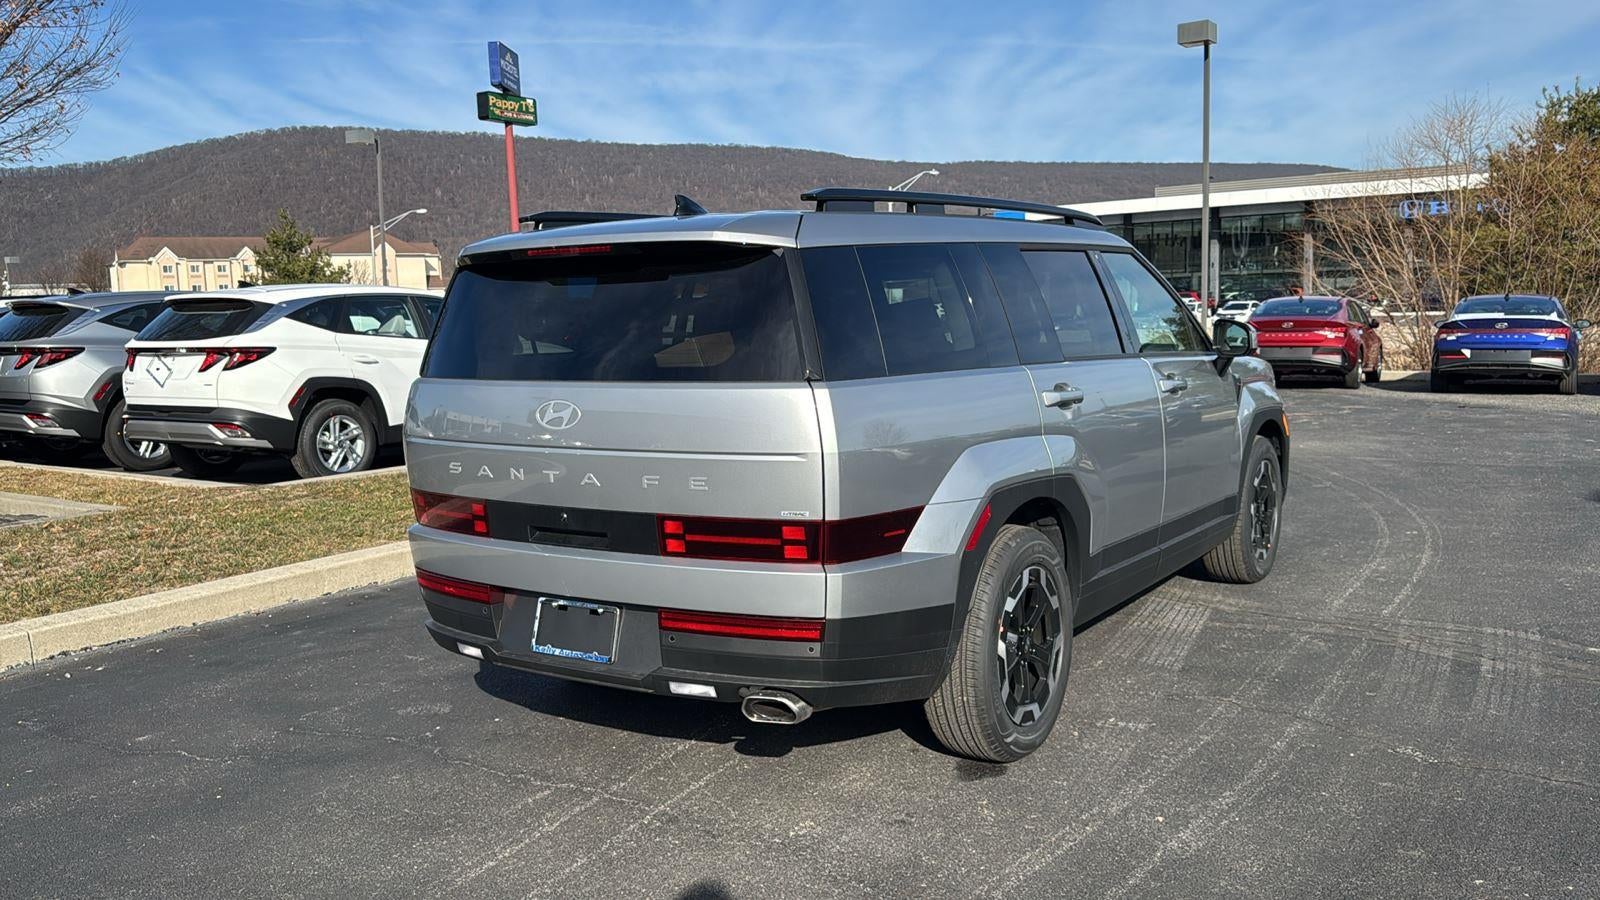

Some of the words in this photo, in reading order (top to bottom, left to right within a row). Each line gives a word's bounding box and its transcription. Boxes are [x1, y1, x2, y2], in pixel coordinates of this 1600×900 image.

[488, 95, 520, 111] Pappy
[448, 461, 601, 488] SANTA
[641, 474, 709, 492] FE
